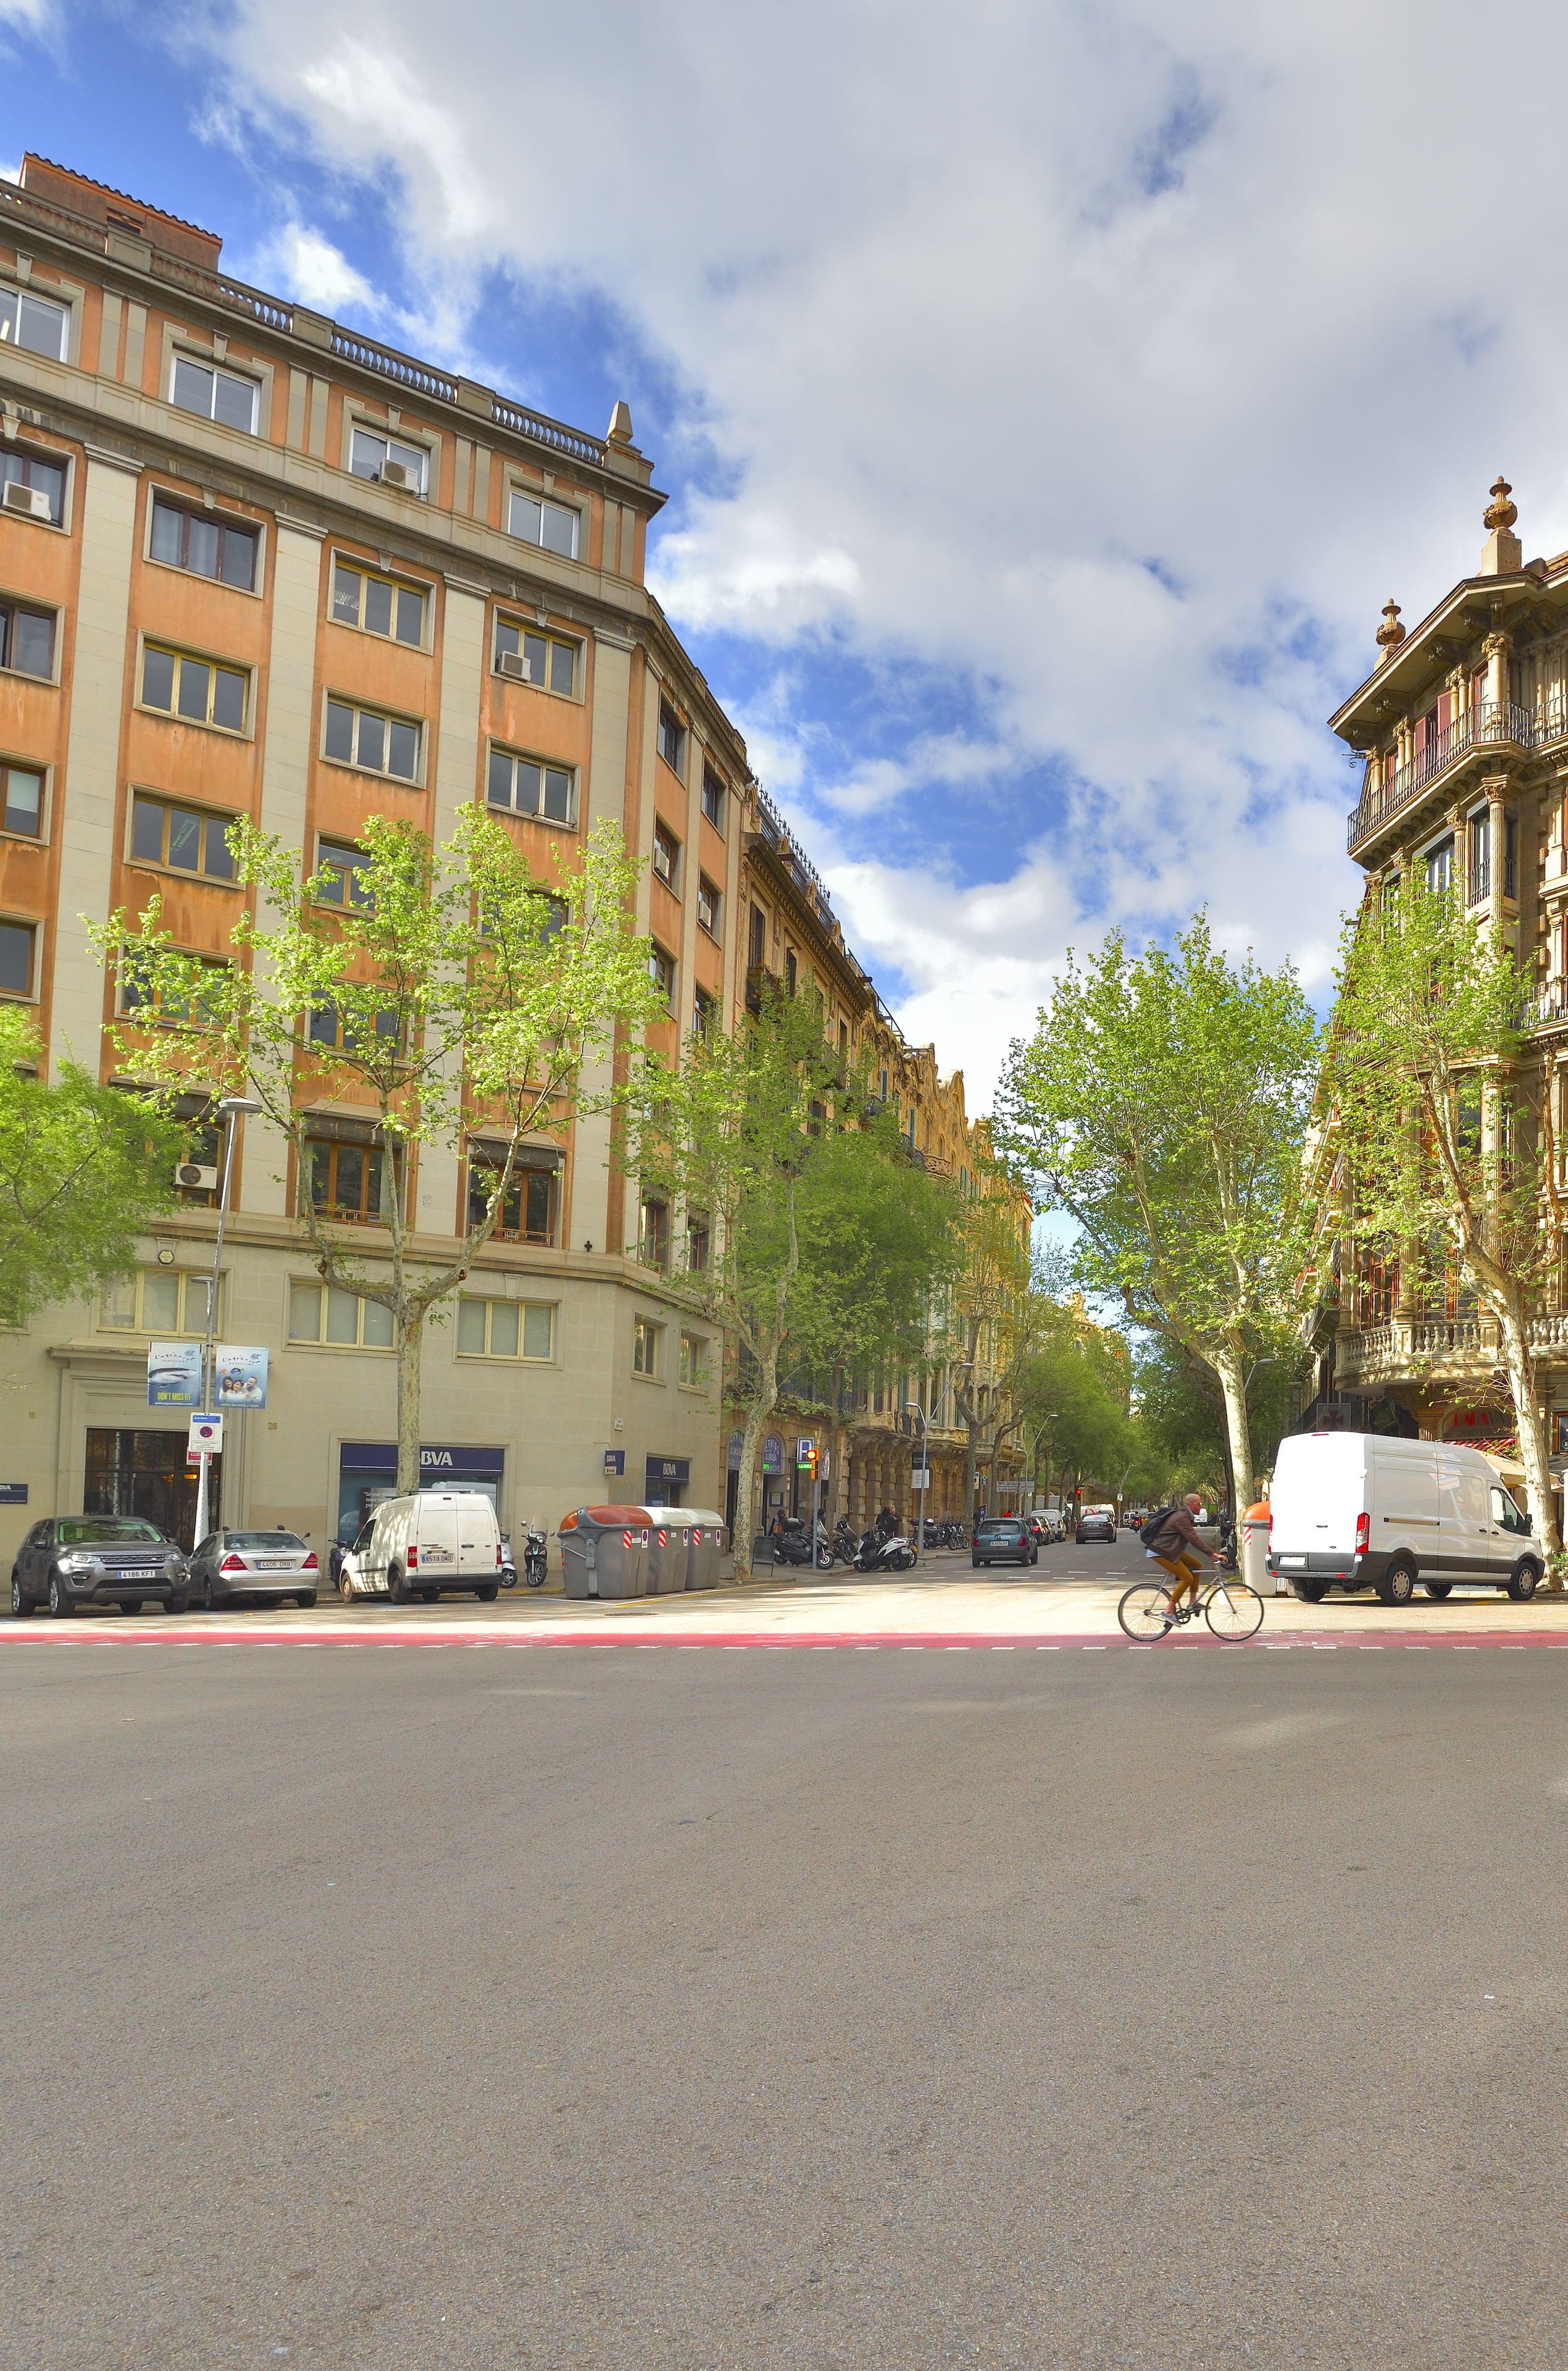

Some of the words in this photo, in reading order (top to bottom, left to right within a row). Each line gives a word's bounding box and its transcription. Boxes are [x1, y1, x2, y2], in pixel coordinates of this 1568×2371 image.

[157, 1392, 171, 1400] DON'T
[172, 1392, 184, 1401] MISS
[799, 1439, 812, 1461] P
[420, 1451, 453, 1466] BVA
[662, 1463, 677, 1476] BBVA
